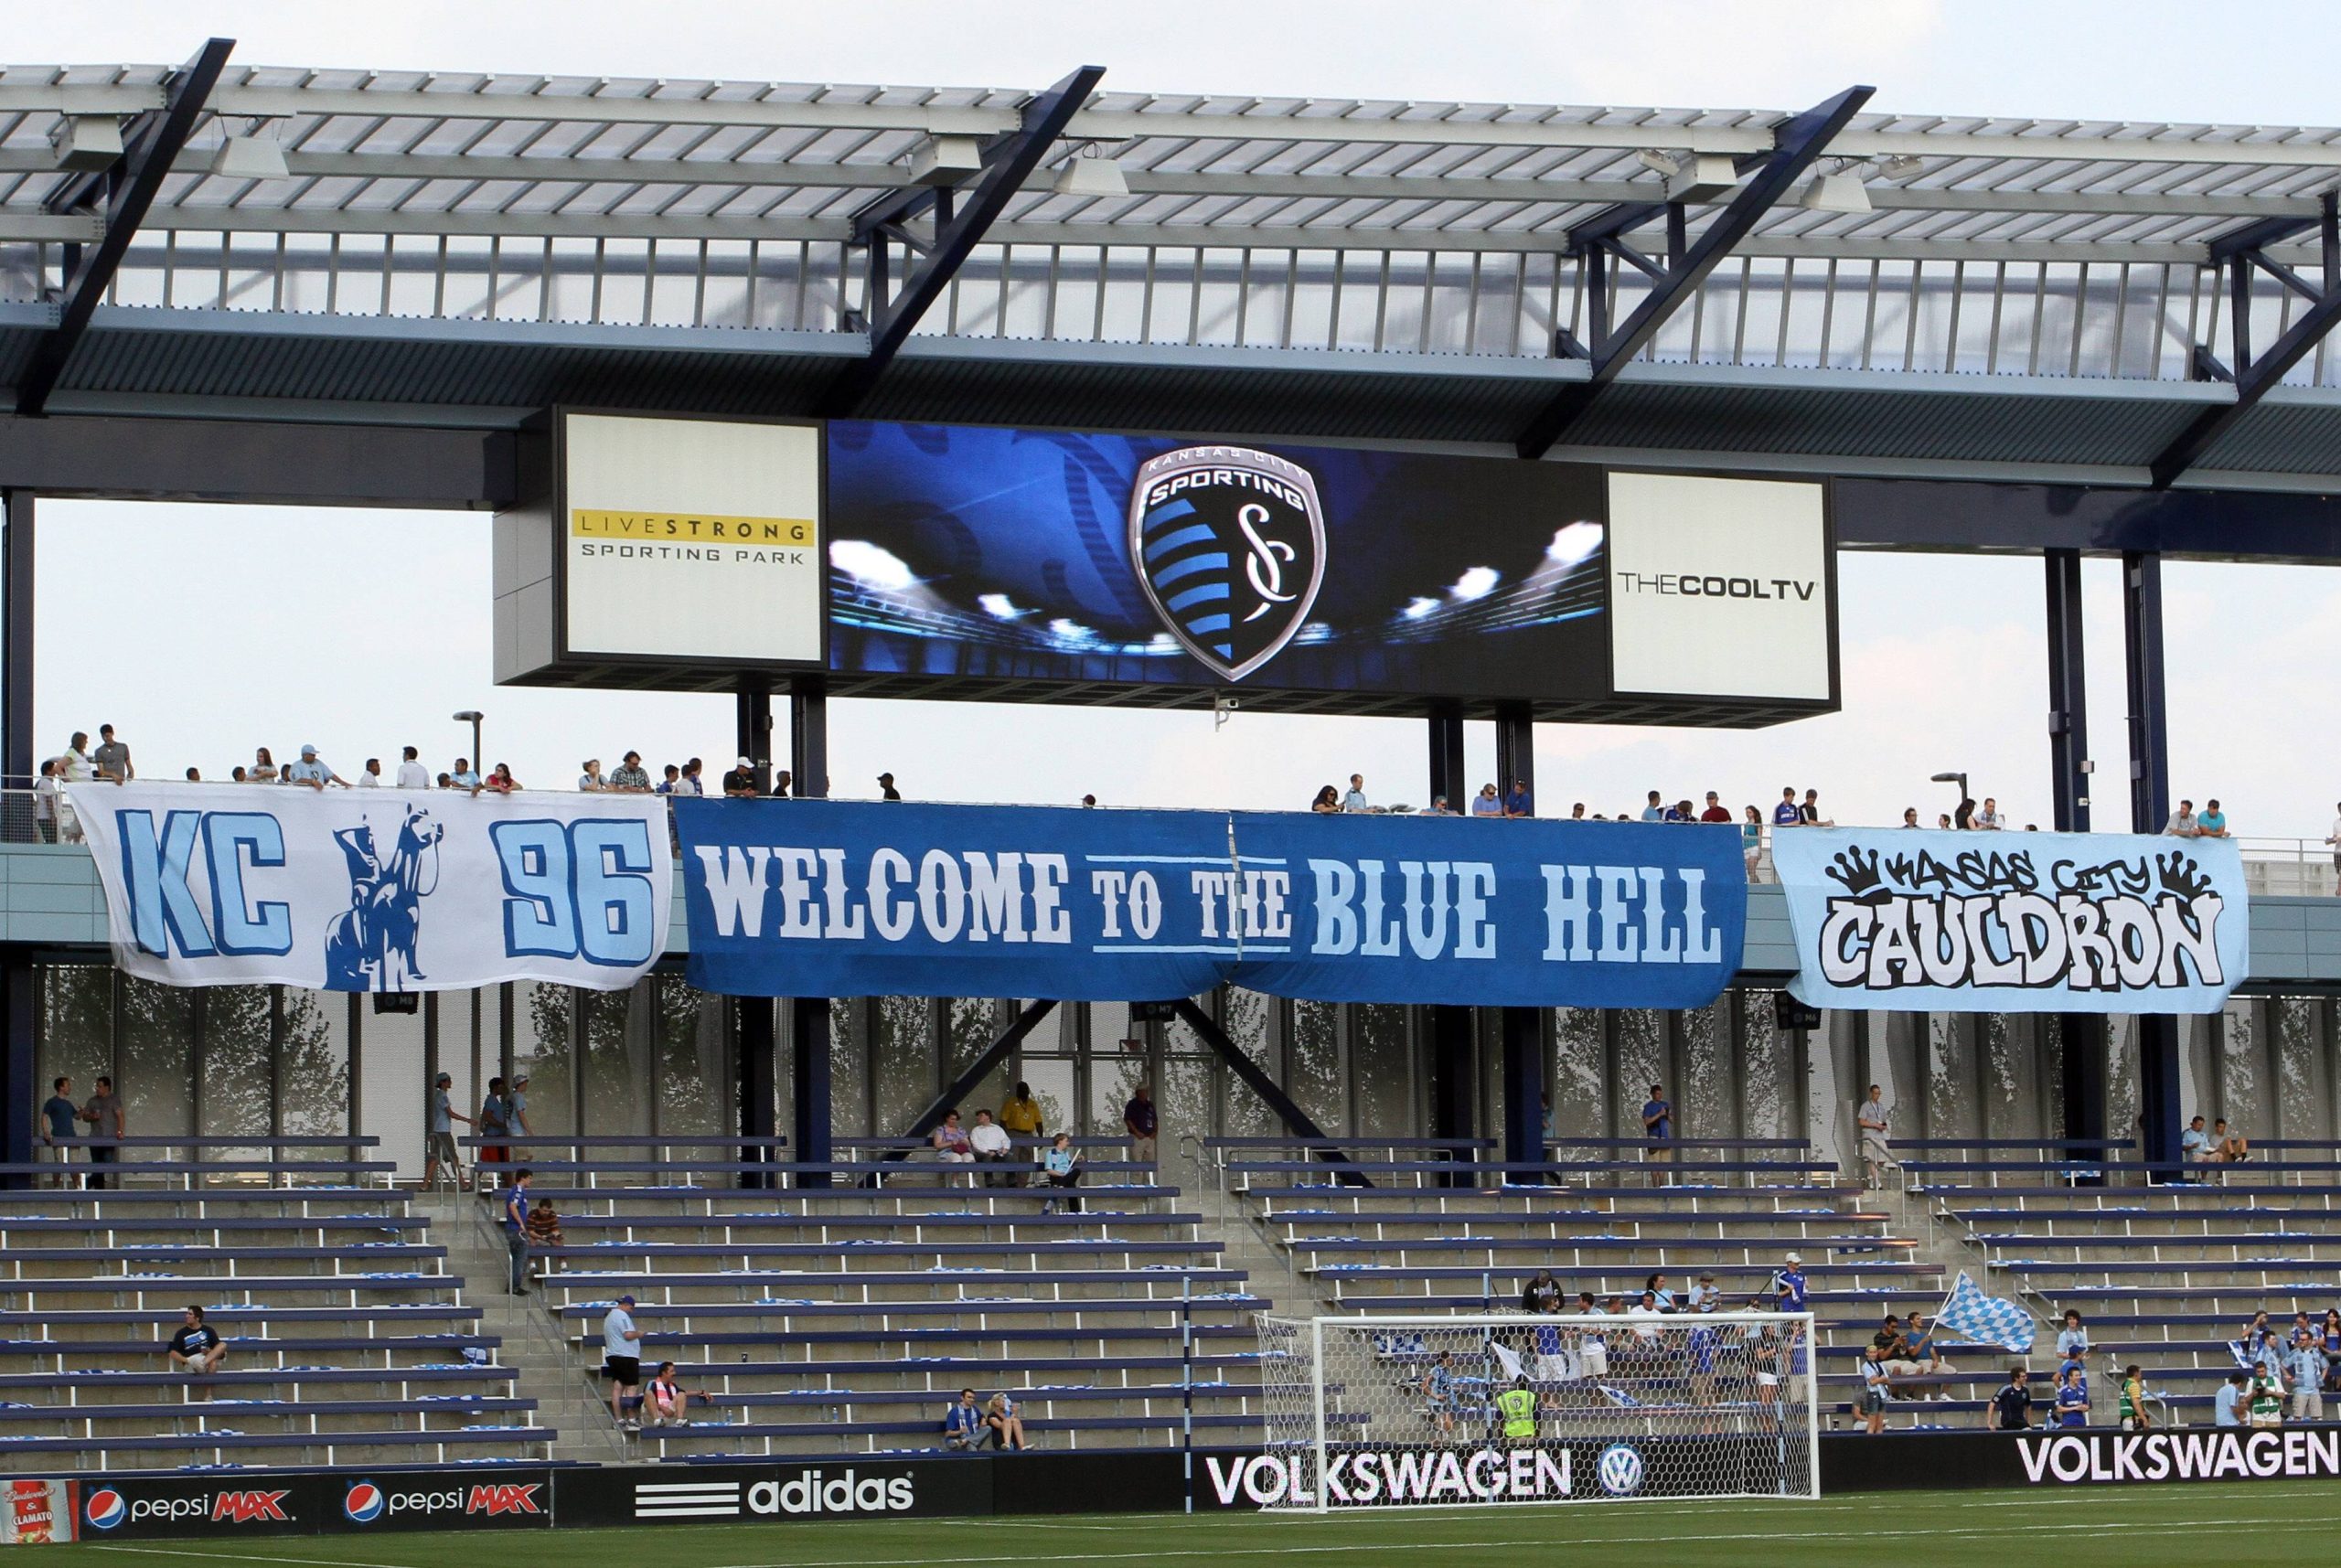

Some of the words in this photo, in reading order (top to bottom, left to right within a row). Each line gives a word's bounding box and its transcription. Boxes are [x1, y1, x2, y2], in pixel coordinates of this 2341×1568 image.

[1149, 448, 1240, 471] KANSAS
[1254, 453, 1306, 478] CITY
[1149, 470, 1304, 511] SPORTING
[582, 516, 805, 540] LIVESTRONG
[582, 544, 720, 561] SPORTING
[735, 550, 805, 565] PARK
[115, 809, 293, 959] KC
[488, 818, 653, 967] 96
[1885, 848, 2039, 891] KANSAS
[2051, 856, 2151, 895] CITY
[694, 845, 1072, 944] WELCOME
[1092, 869, 1162, 941] TO
[1192, 870, 1291, 939] THE
[1308, 858, 1496, 960] BLUE
[1540, 863, 1722, 964] HELL
[1819, 888, 2224, 993] CAULDRON
[1205, 1448, 1571, 1506] VOLKSWAGEN
[2015, 1431, 2339, 1483] VOLKSWAGEN
[131, 1493, 208, 1522] pepsi
[211, 1488, 292, 1523] MAX
[388, 1487, 464, 1519] pepsi
[466, 1483, 544, 1517] MAX
[747, 1468, 914, 1514] adidas
[12, 1510, 53, 1526] CLAMATO
